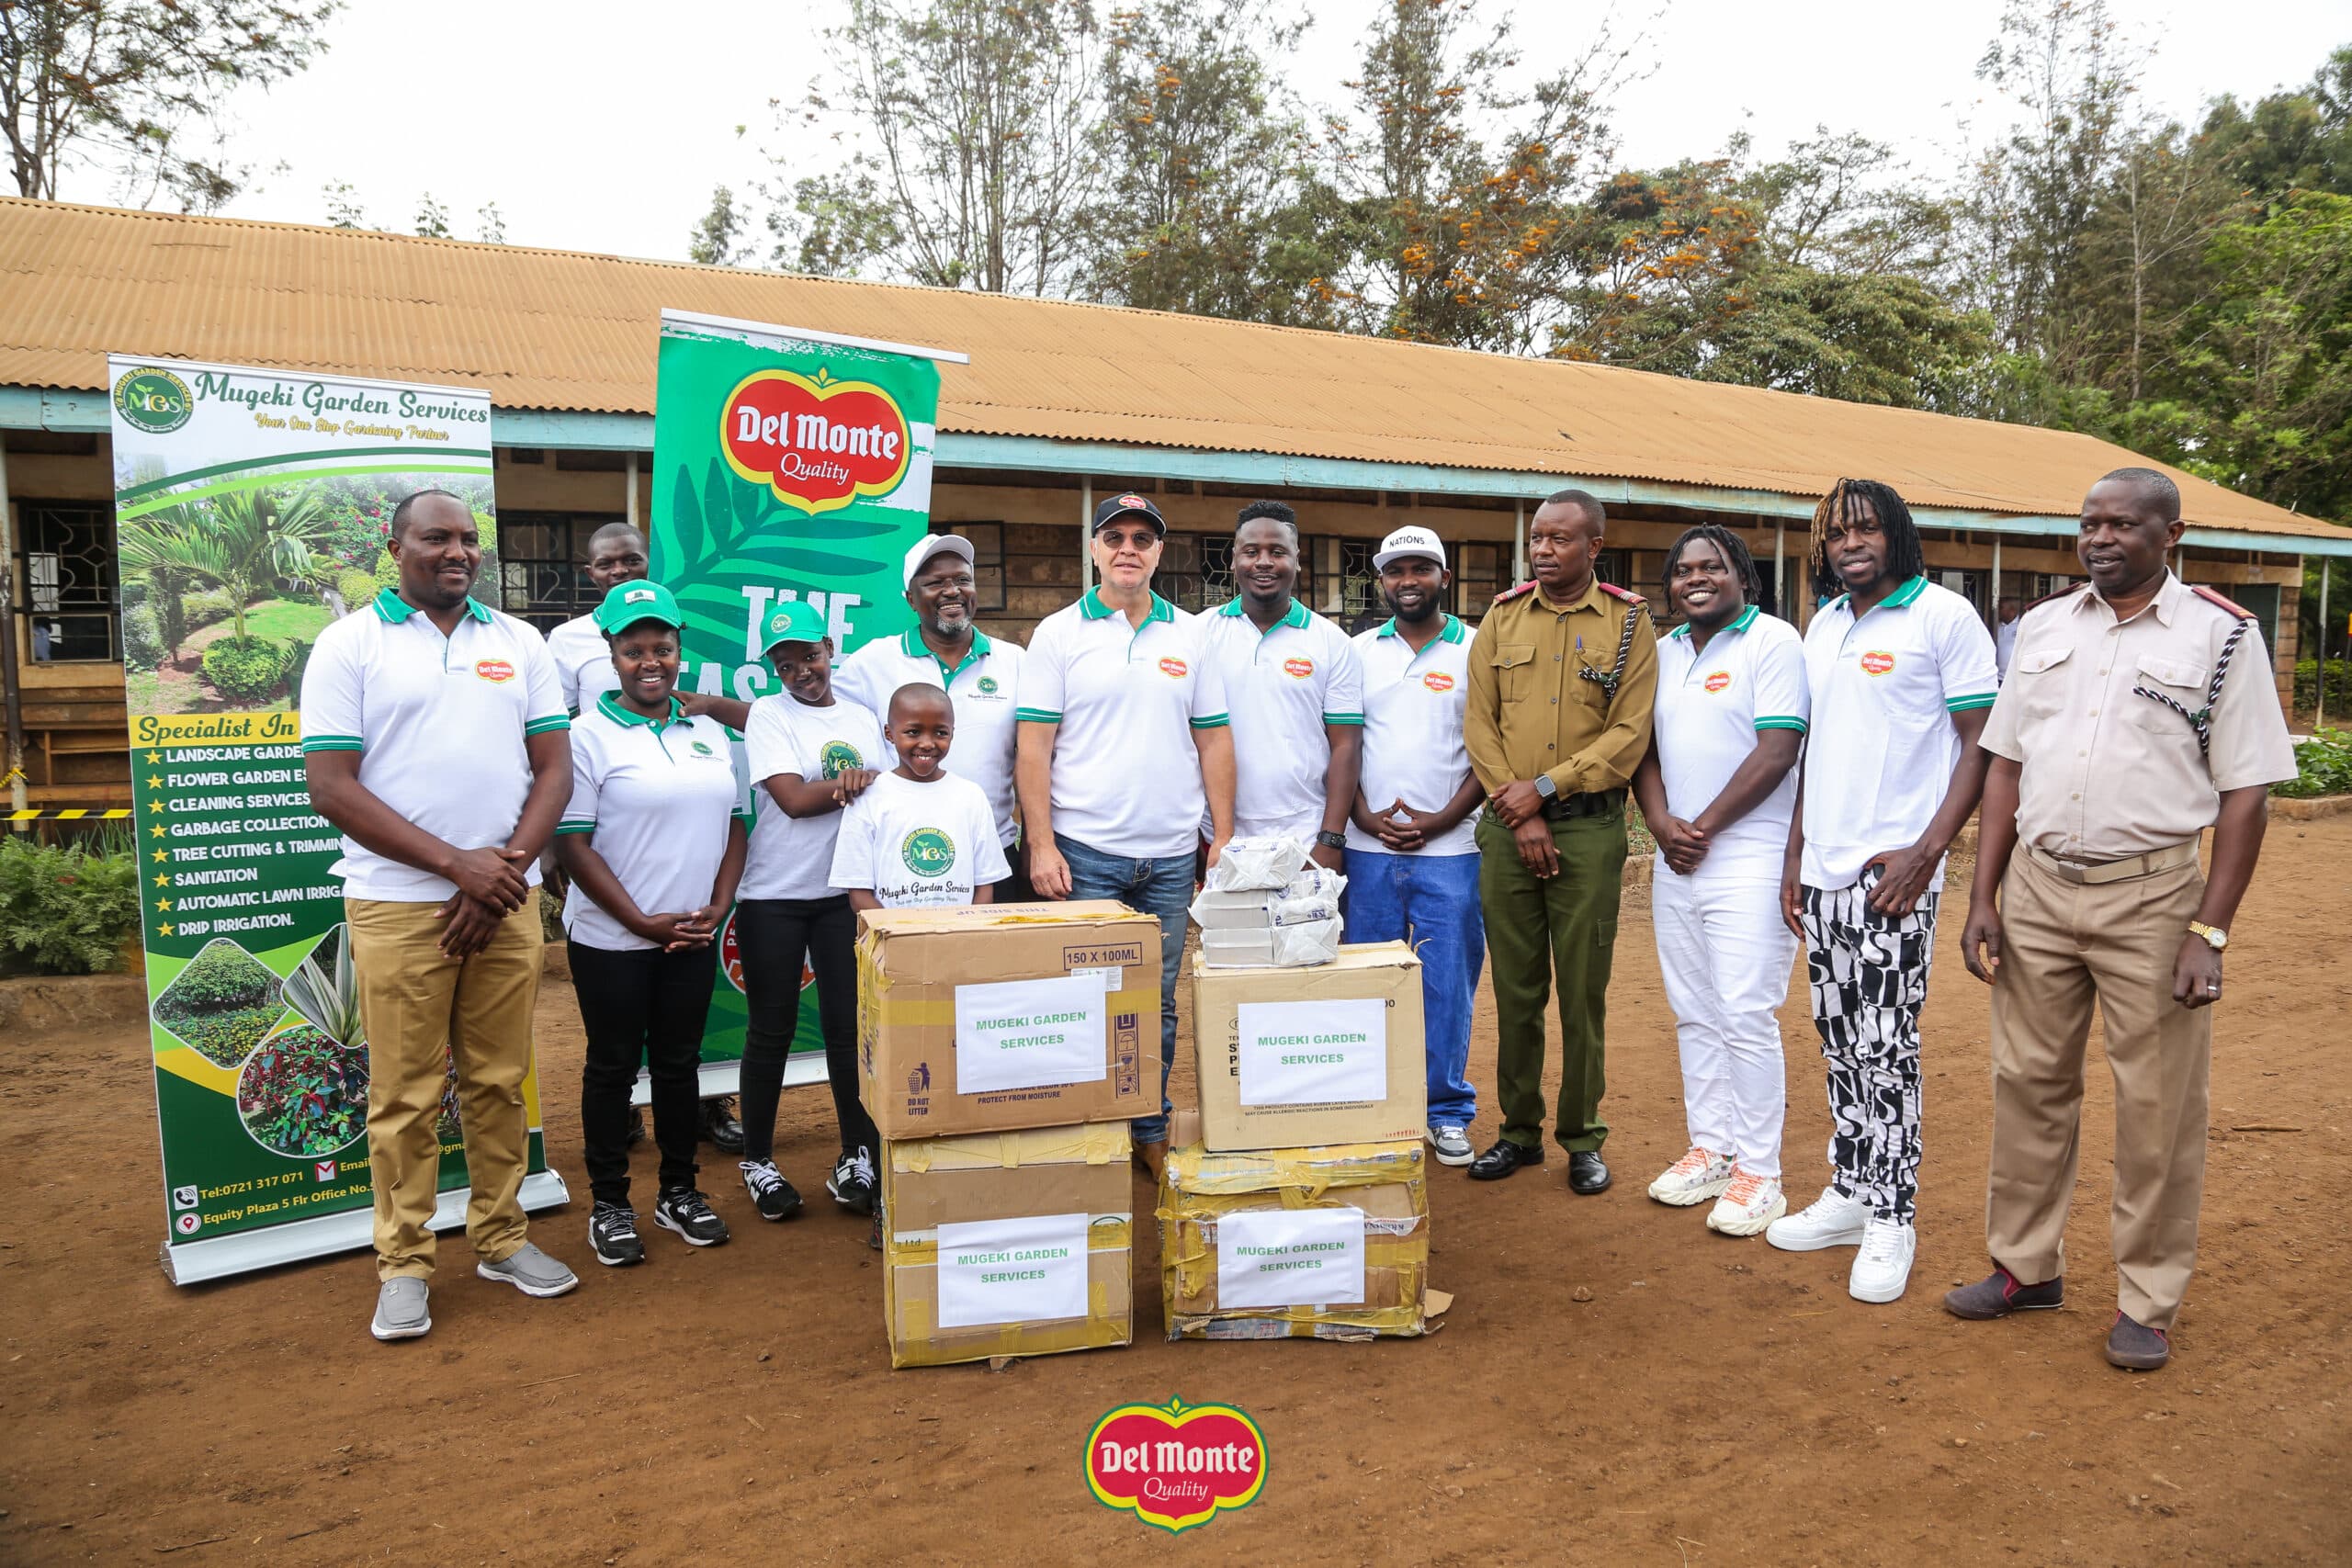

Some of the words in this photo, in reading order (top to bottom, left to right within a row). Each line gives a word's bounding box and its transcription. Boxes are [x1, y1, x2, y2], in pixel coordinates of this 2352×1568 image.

[195, 372, 295, 411] Mugeki
[302, 382, 390, 416] Garden
[399, 390, 487, 423] Services
[254, 412, 287, 429] Your
[288, 414, 311, 430] One
[315, 417, 340, 436] Stop
[344, 420, 403, 441] Gardening
[406, 424, 449, 442] Partner
[737, 405, 790, 447] Del
[795, 413, 899, 460] Monte
[780, 453, 850, 486] Quality
[1389, 535, 1425, 548] NATIONS
[139, 716, 253, 745] Specialist
[260, 714, 296, 738] In
[165, 747, 251, 763] LANDSCAPE
[167, 772, 231, 787] FLOWER
[232, 769, 290, 784] GARDEN
[168, 795, 243, 812] CLEANING
[246, 793, 311, 808] SERVICES
[170, 819, 241, 837] GARBAGE
[243, 816, 330, 832] COLLECTION
[173, 846, 209, 862] TREE
[210, 842, 272, 859] CUTTING
[276, 840, 286, 853] &
[175, 867, 258, 886] SANITATION
[910, 881, 943, 897] Garden
[945, 880, 970, 894] Services
[176, 891, 261, 911] AUTOMATIC
[262, 887, 303, 904] LAWN
[306, 885, 343, 900] IRRIG
[178, 921, 209, 937] DRIP
[213, 913, 295, 933] IRRIGATION.
[1067, 952, 1087, 964] 150
[1090, 951, 1099, 963] X
[1102, 948, 1138, 963] 100ML
[976, 1016, 1029, 1031] MUGEKI
[1033, 1011, 1087, 1026] GARDEN
[1000, 1033, 1065, 1050] SERVICES
[1258, 1036, 1309, 1046] MUGEKI
[1313, 1033, 1366, 1044] GARDEN
[1281, 1054, 1344, 1065] SERVICES
[908, 1098, 917, 1106] DO
[978, 1095, 1007, 1104] PROTECT
[1008, 1094, 1027, 1102] FROM
[1028, 1090, 1061, 1100] MOISTURE
[908, 1107, 928, 1116] LITTER
[199, 1180, 252, 1200] Tel:0721
[256, 1176, 278, 1190] 317
[282, 1171, 304, 1184] 071
[203, 1209, 243, 1224] Equity
[247, 1201, 279, 1215] Plaza
[282, 1199, 289, 1208] 5
[292, 1195, 309, 1207] Flr
[311, 1189, 346, 1202] Office
[957, 1253, 1011, 1265] MUGEKI
[1014, 1248, 1068, 1261] GARDEN
[1237, 1247, 1288, 1257] MUGEKI
[1292, 1242, 1345, 1253] GARDEN
[1259, 1259, 1322, 1272] SERVICES
[981, 1269, 1046, 1283] SERVICES
